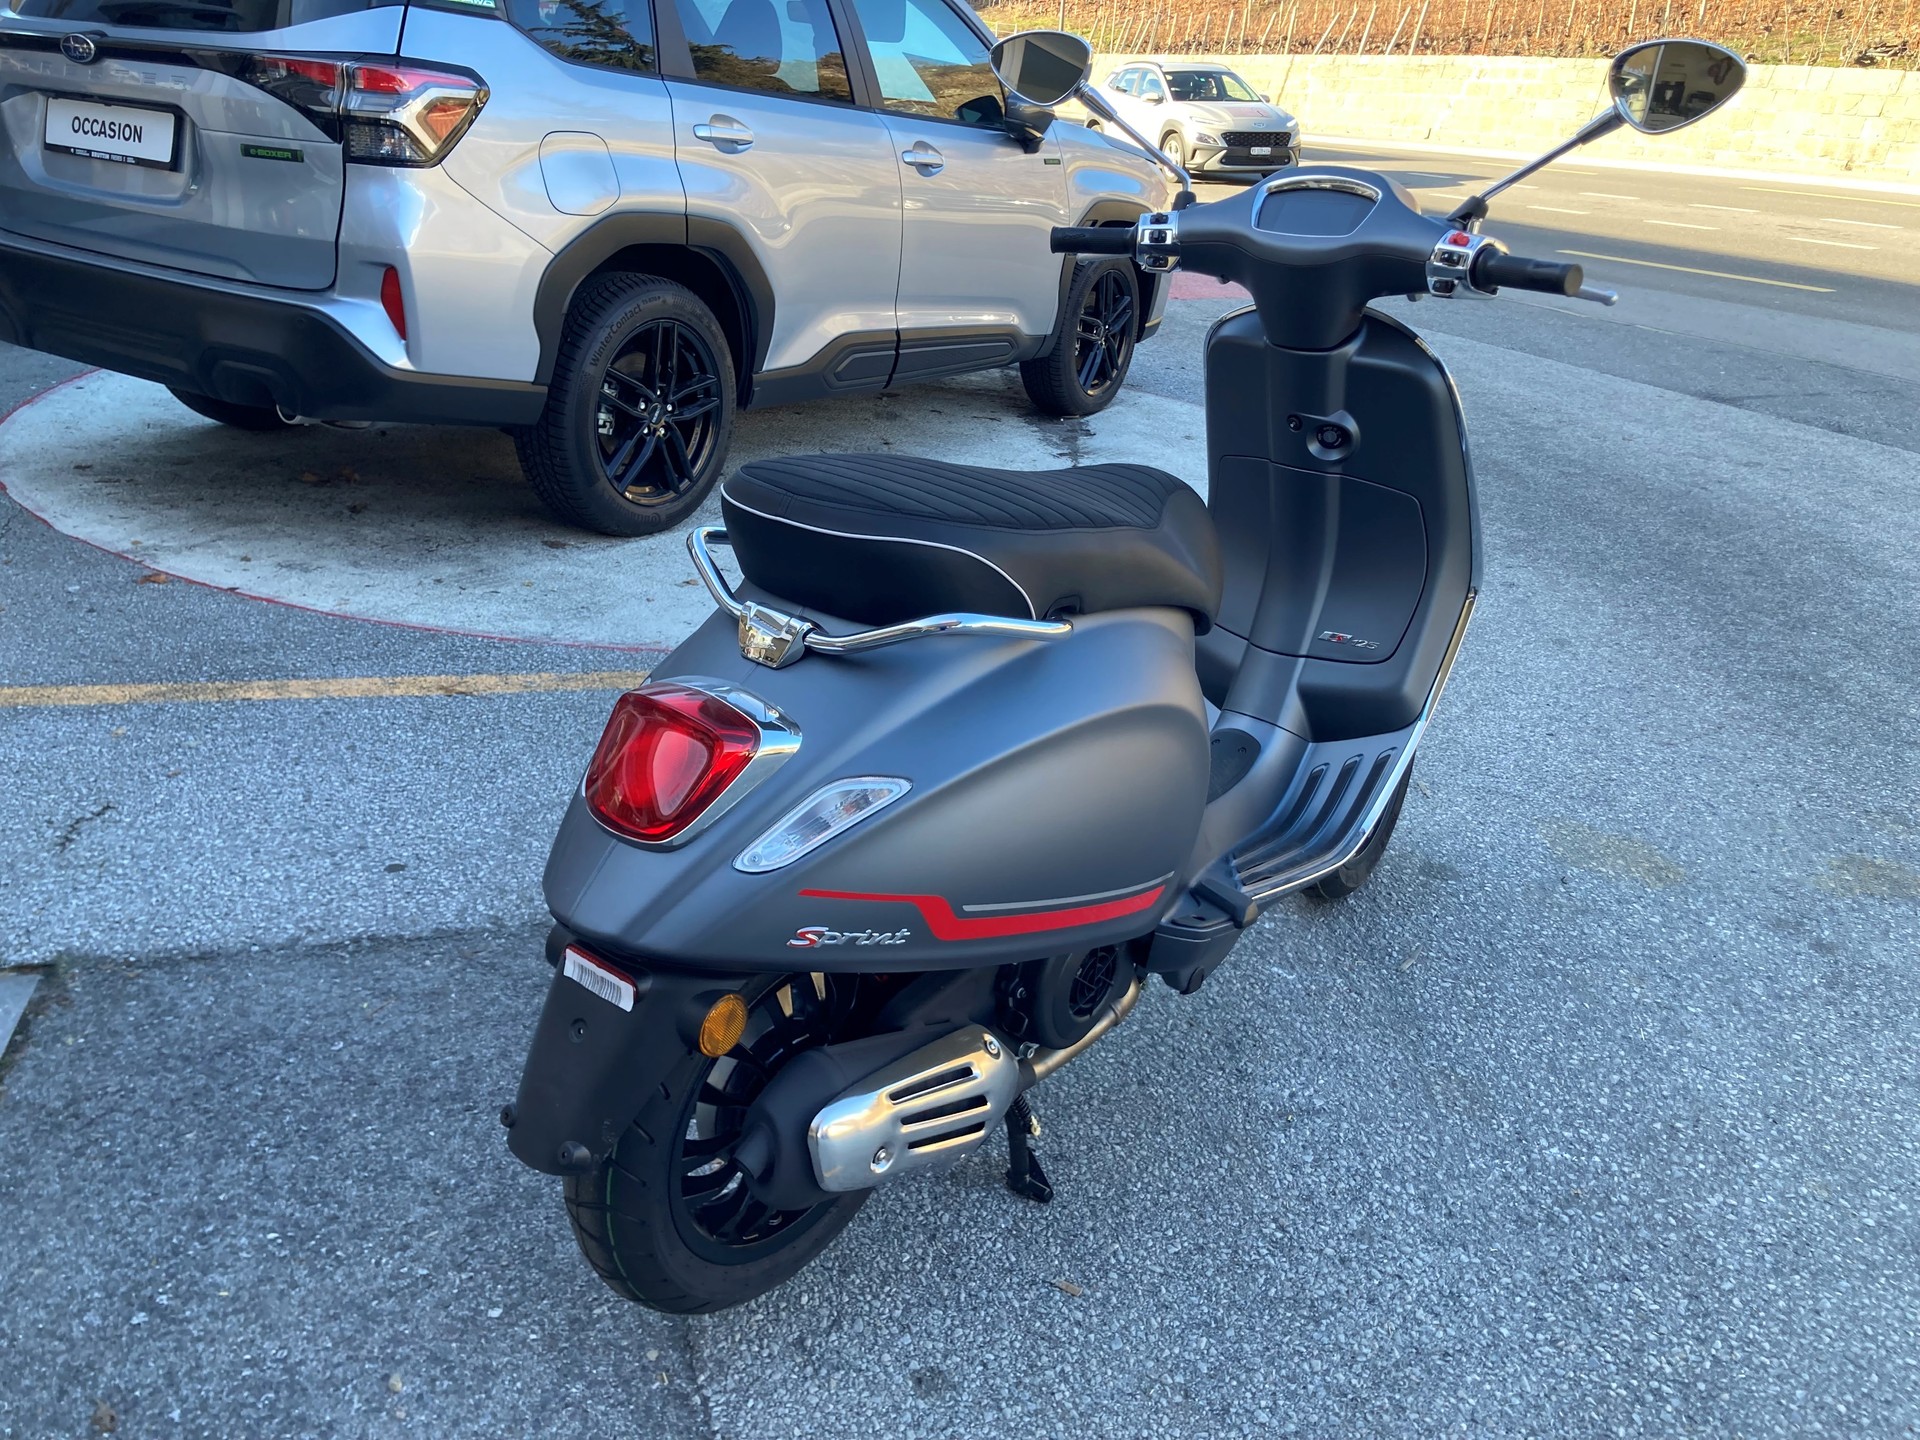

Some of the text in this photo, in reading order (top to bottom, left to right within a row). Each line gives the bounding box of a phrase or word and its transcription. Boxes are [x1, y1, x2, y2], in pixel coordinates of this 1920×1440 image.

[71, 116, 143, 143] OCCASION
[589, 302, 643, 367] WinterContact
[1351, 639, 1381, 650] 125
[786, 926, 911, 948] Sprint
